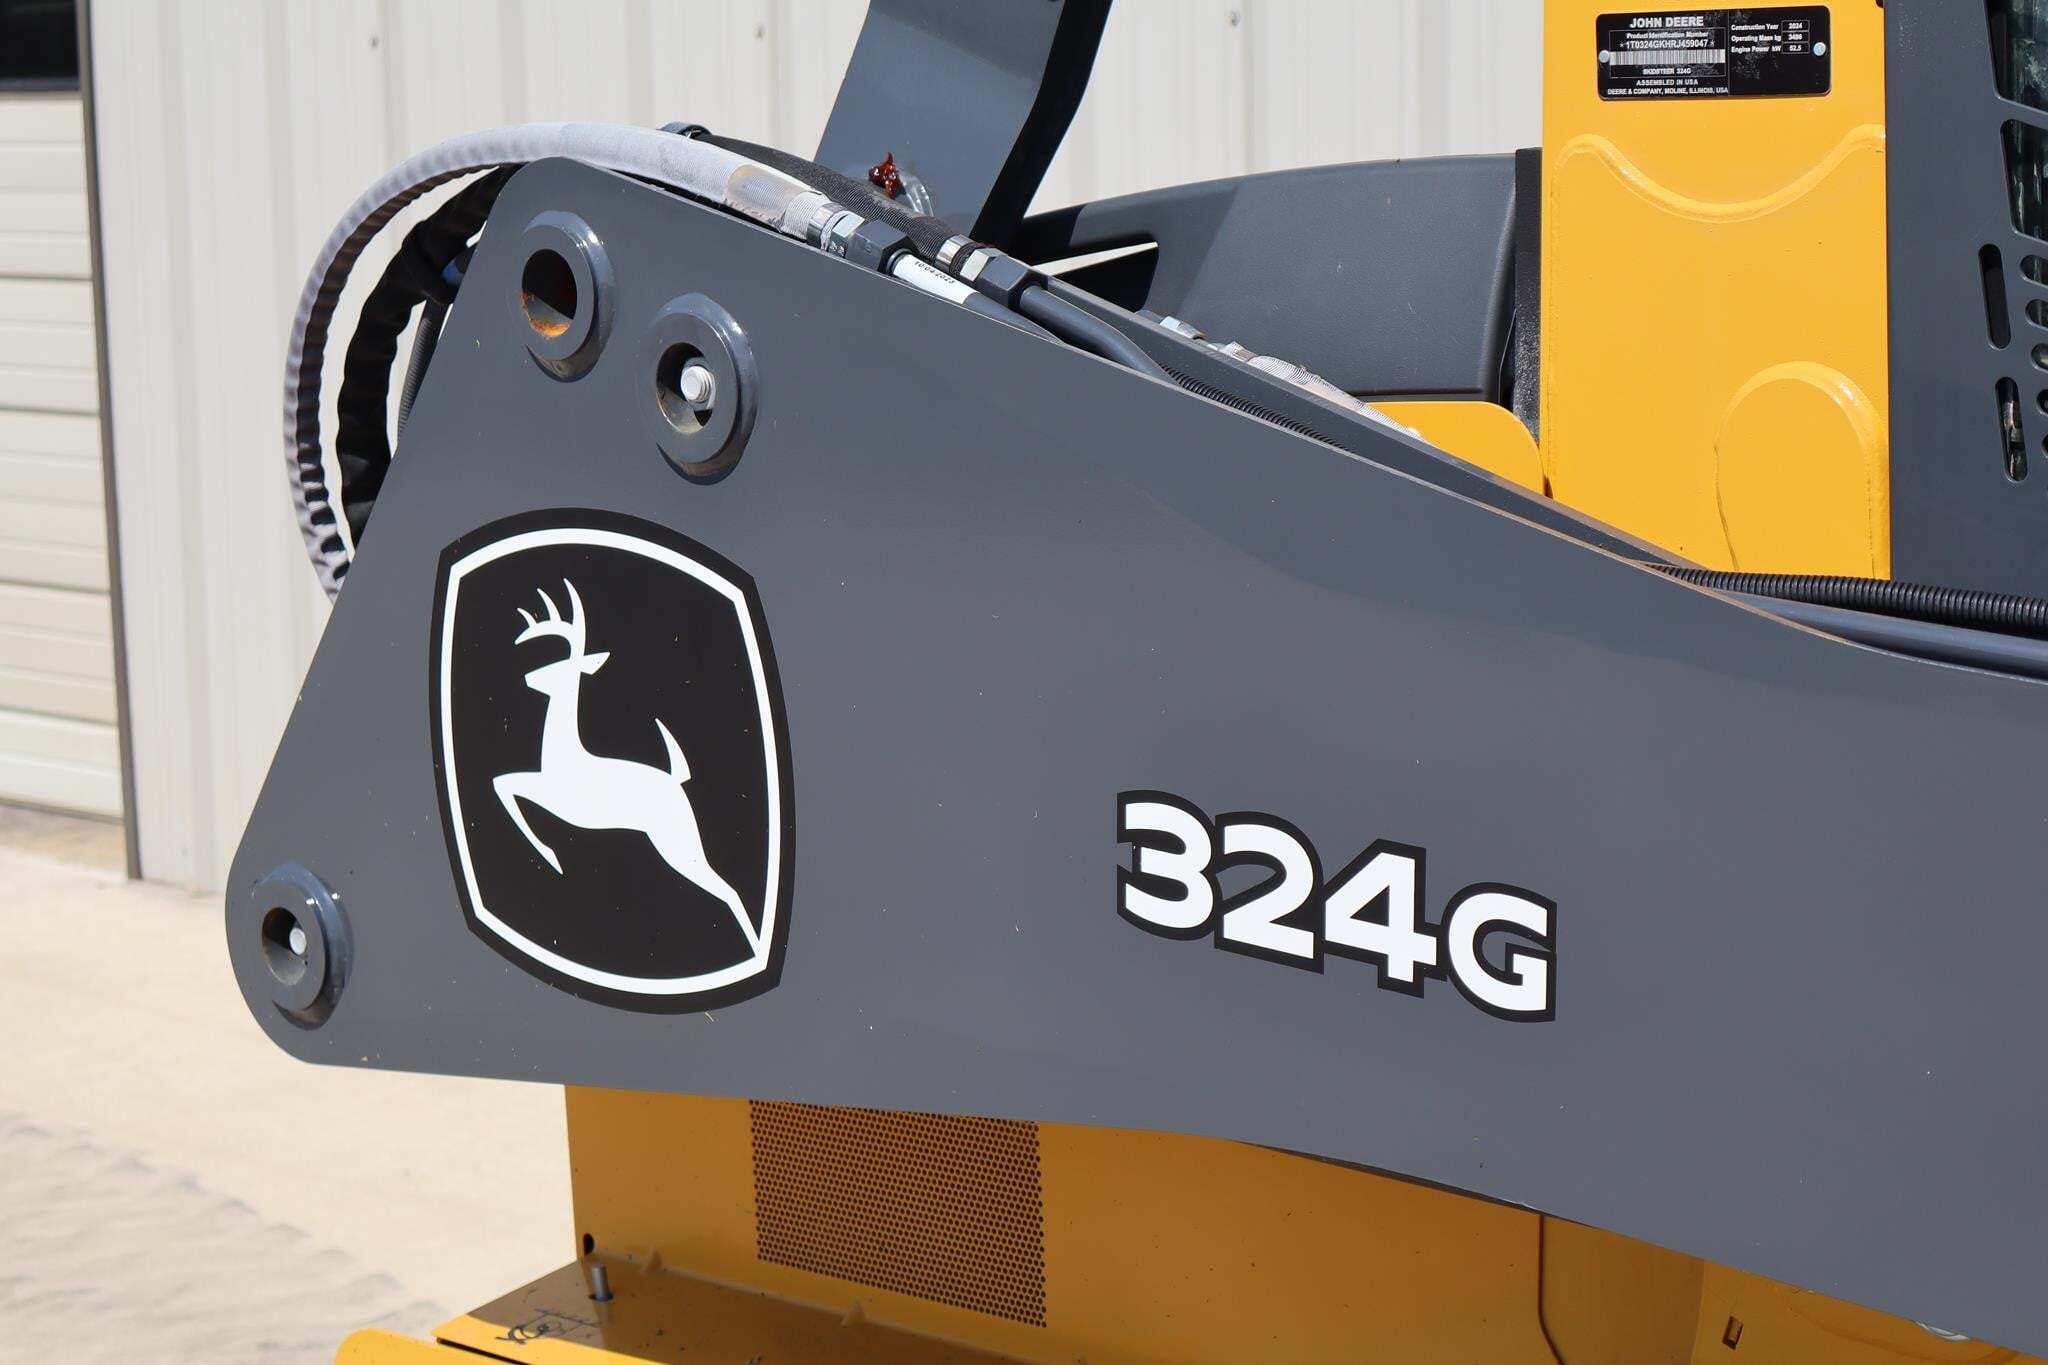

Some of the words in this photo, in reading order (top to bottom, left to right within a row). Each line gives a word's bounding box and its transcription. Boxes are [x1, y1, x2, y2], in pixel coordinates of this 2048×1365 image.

[1629, 17, 1662, 28] JOHN
[1665, 16, 1704, 27] DEERE
[1730, 23, 1766, 31] Construction
[1648, 31, 1685, 39] Identification
[1730, 35, 1758, 43] Operating
[1730, 45, 1751, 54] Engine
[1664, 87, 1688, 95] MOLINE,
[1122, 800, 1549, 1013] 324G
